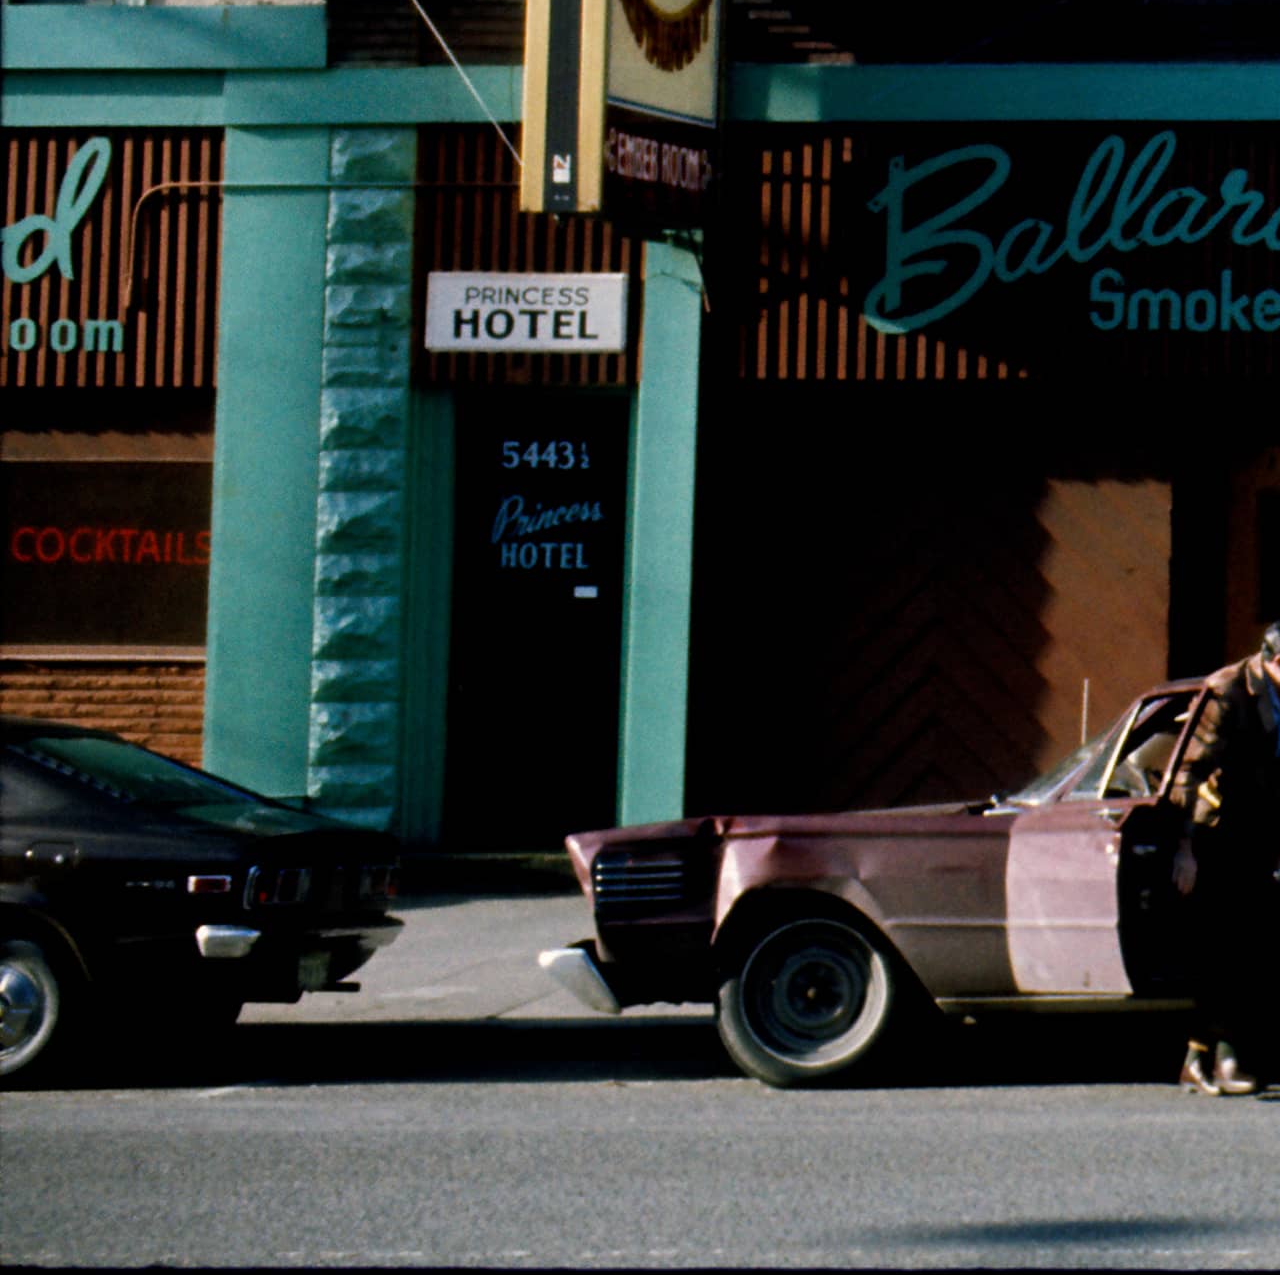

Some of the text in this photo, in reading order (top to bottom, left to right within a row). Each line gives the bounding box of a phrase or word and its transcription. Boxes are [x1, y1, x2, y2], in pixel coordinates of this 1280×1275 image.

[464, 285, 591, 307] PRINCESS
[452, 309, 599, 341] HOTEL
[489, 492, 607, 547] Princess
[8, 526, 210, 565] COCKTAILS
[500, 540, 591, 570] HOTEL
